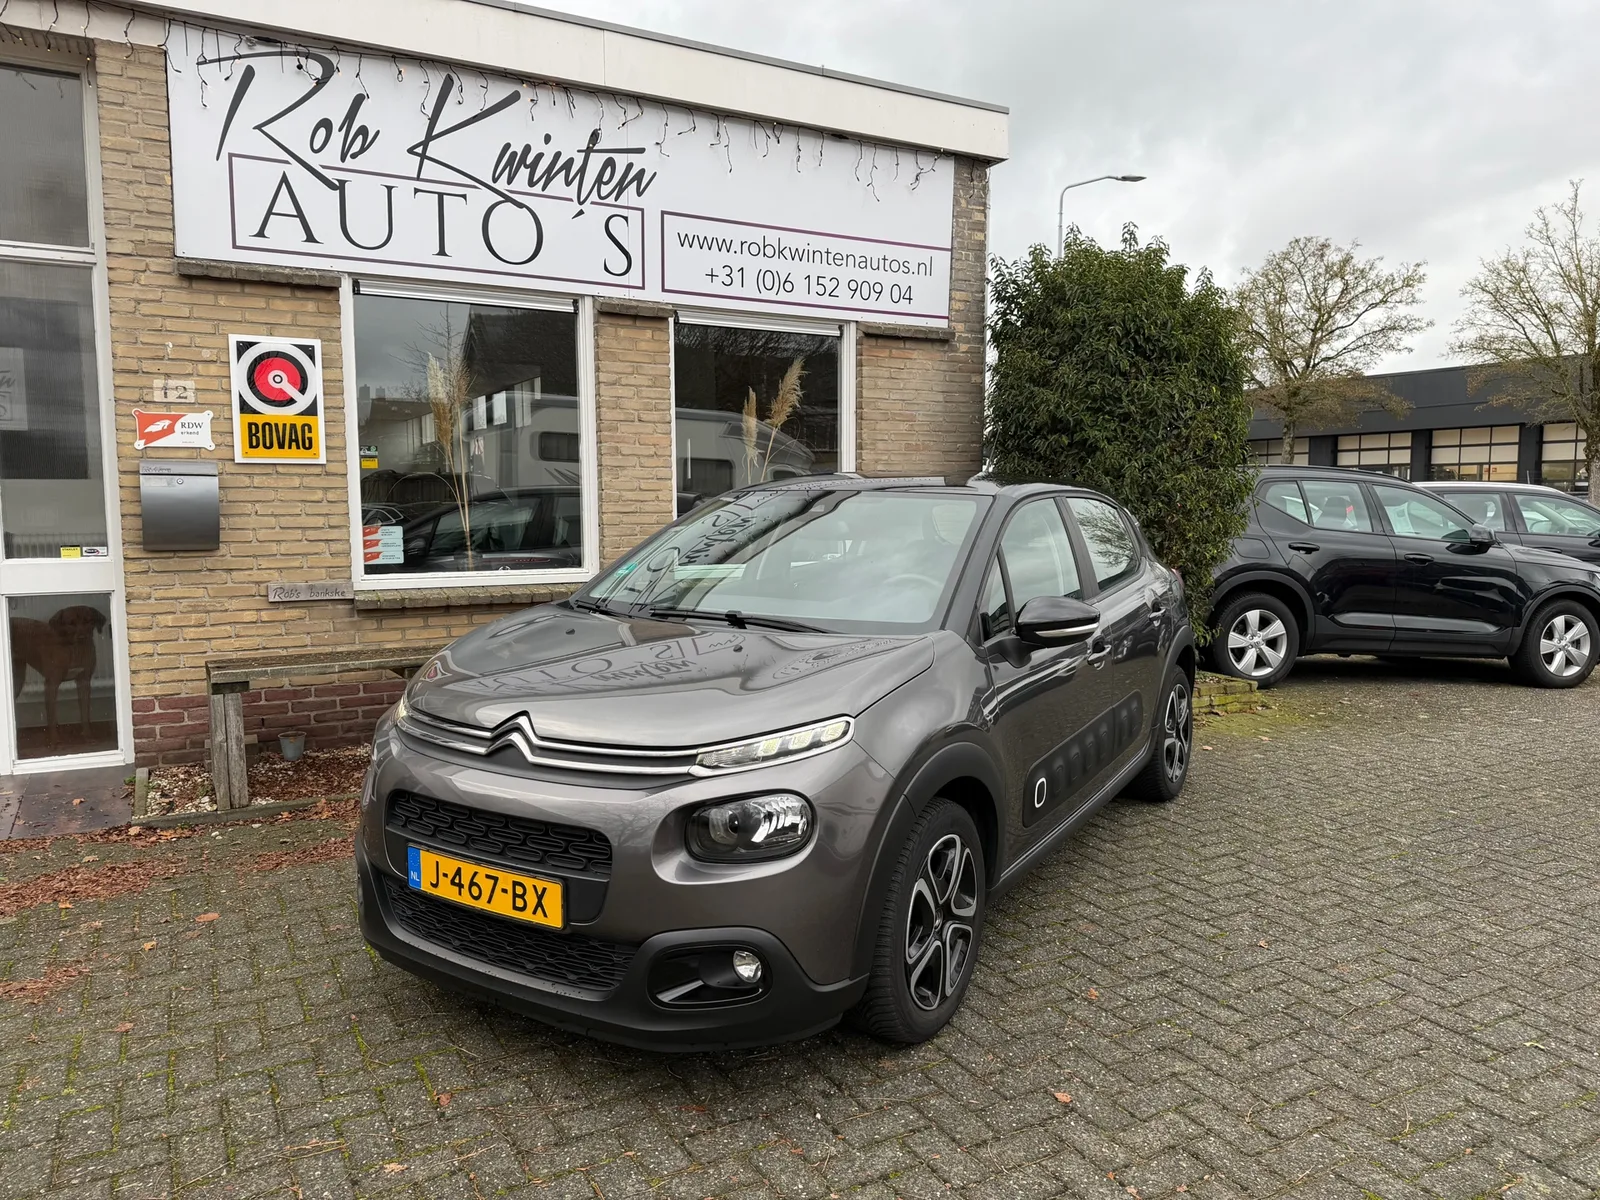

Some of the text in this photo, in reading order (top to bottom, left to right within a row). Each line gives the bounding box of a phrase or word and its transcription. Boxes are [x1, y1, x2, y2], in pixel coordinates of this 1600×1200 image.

[196, 50, 657, 209] Rob Kwinten
[677, 231, 933, 277] www.robkwintenautos.nl
[705, 264, 913, 305] +31 (0)6 152 909 04
[180, 421, 204, 429] RDW
[247, 421, 313, 451] BOVAG
[272, 586, 346, 600] Rob's bankske
[410, 870, 420, 882] NL
[429, 860, 549, 918] J-467-BX
